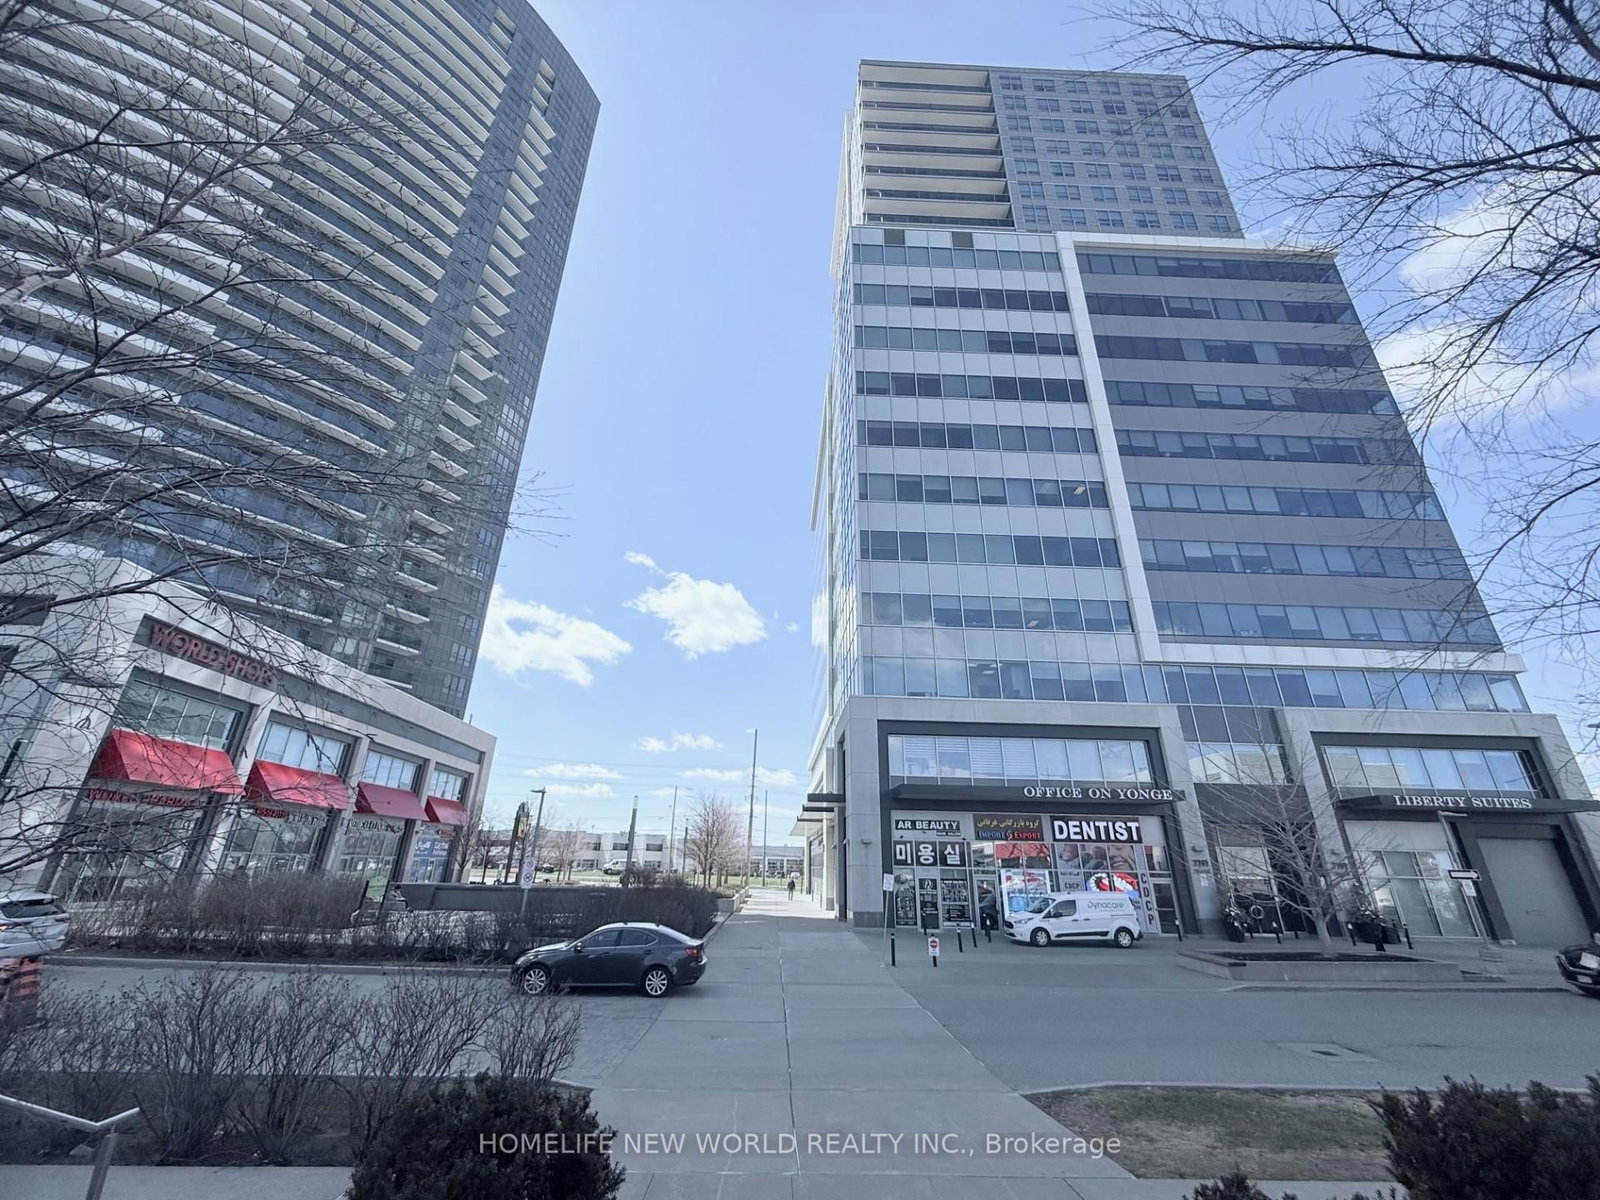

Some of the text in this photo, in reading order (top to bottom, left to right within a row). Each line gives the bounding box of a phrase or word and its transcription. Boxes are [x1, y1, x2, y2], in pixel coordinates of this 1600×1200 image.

[1024, 787, 1173, 801] OFFICE ON YONGE
[1393, 795, 1533, 809] LIBERTY SUITES
[897, 820, 958, 830] AR BEAUTY
[1053, 820, 1140, 841] DENTIST
[978, 831, 1006, 839] IMPORT
[1013, 831, 1041, 839] EXPORT
[895, 842, 961, 866] 미용실
